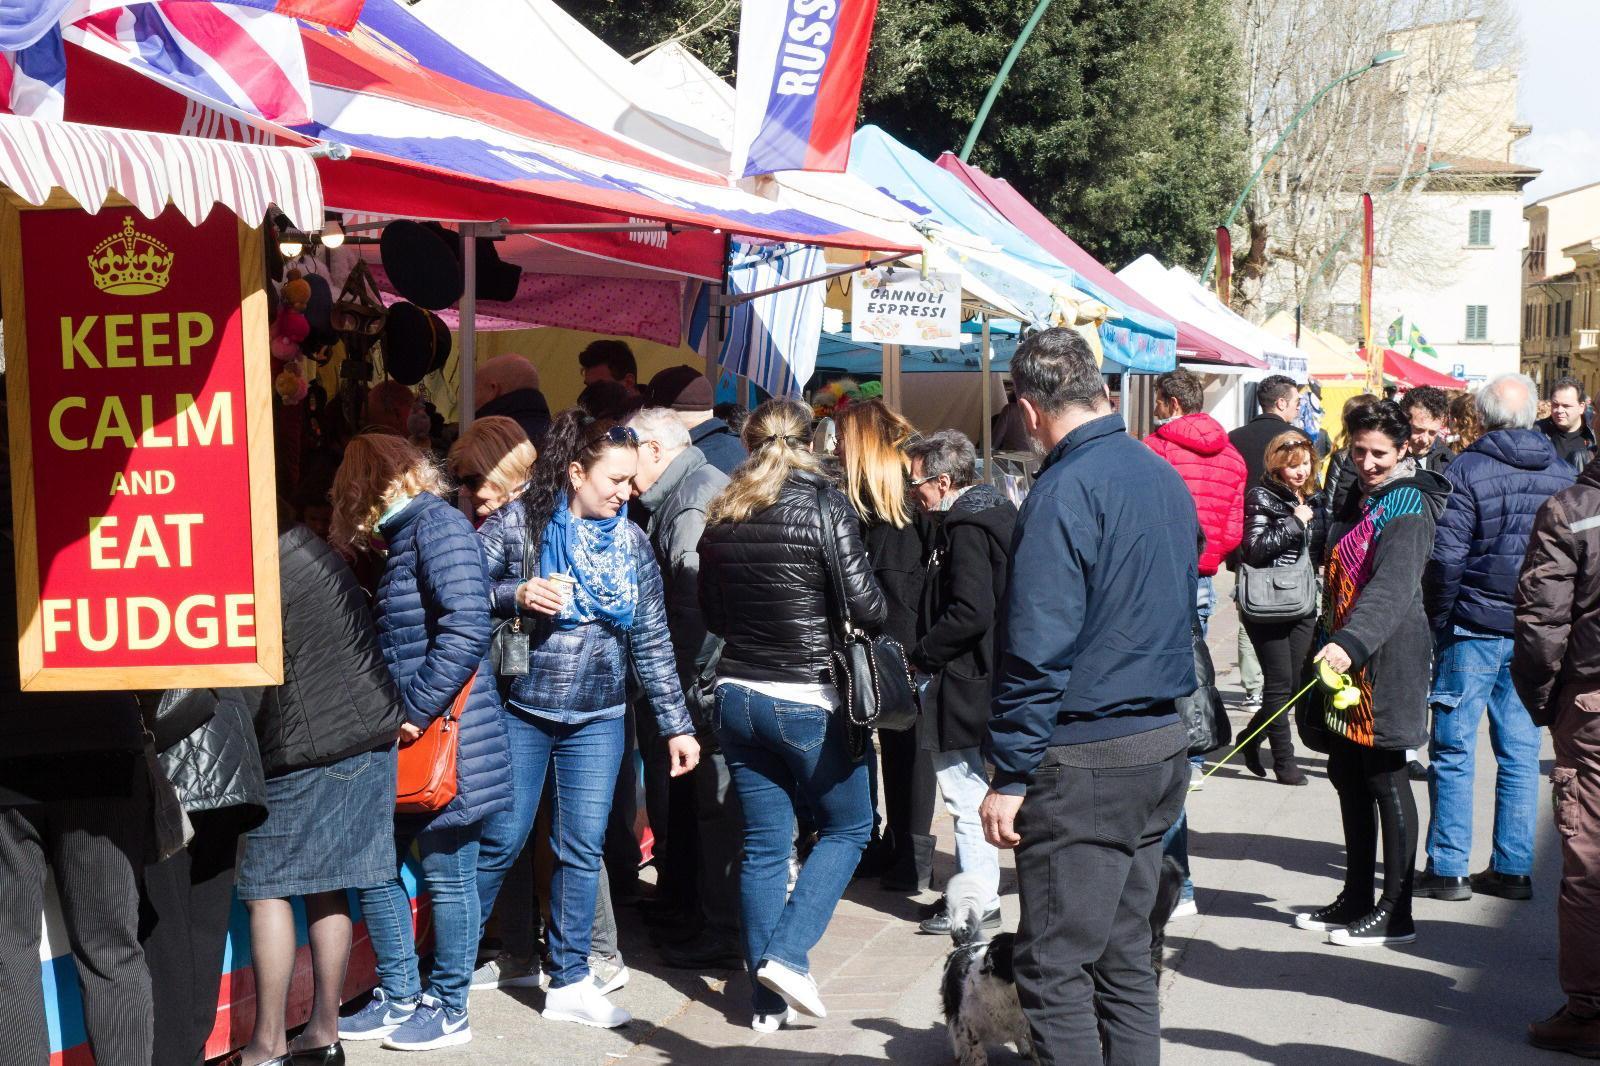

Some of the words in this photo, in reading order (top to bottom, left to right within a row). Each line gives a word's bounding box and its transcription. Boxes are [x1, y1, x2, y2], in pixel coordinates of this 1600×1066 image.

[776, 0, 836, 96] RUSS
[867, 302, 946, 318] ESPRESSI
[870, 288, 944, 304] CANNOLI
[60, 311, 214, 370] KEEP
[48, 391, 235, 452] CALM
[109, 469, 176, 496] AND
[88, 513, 204, 570] EAT
[42, 593, 257, 654] FUDGE
